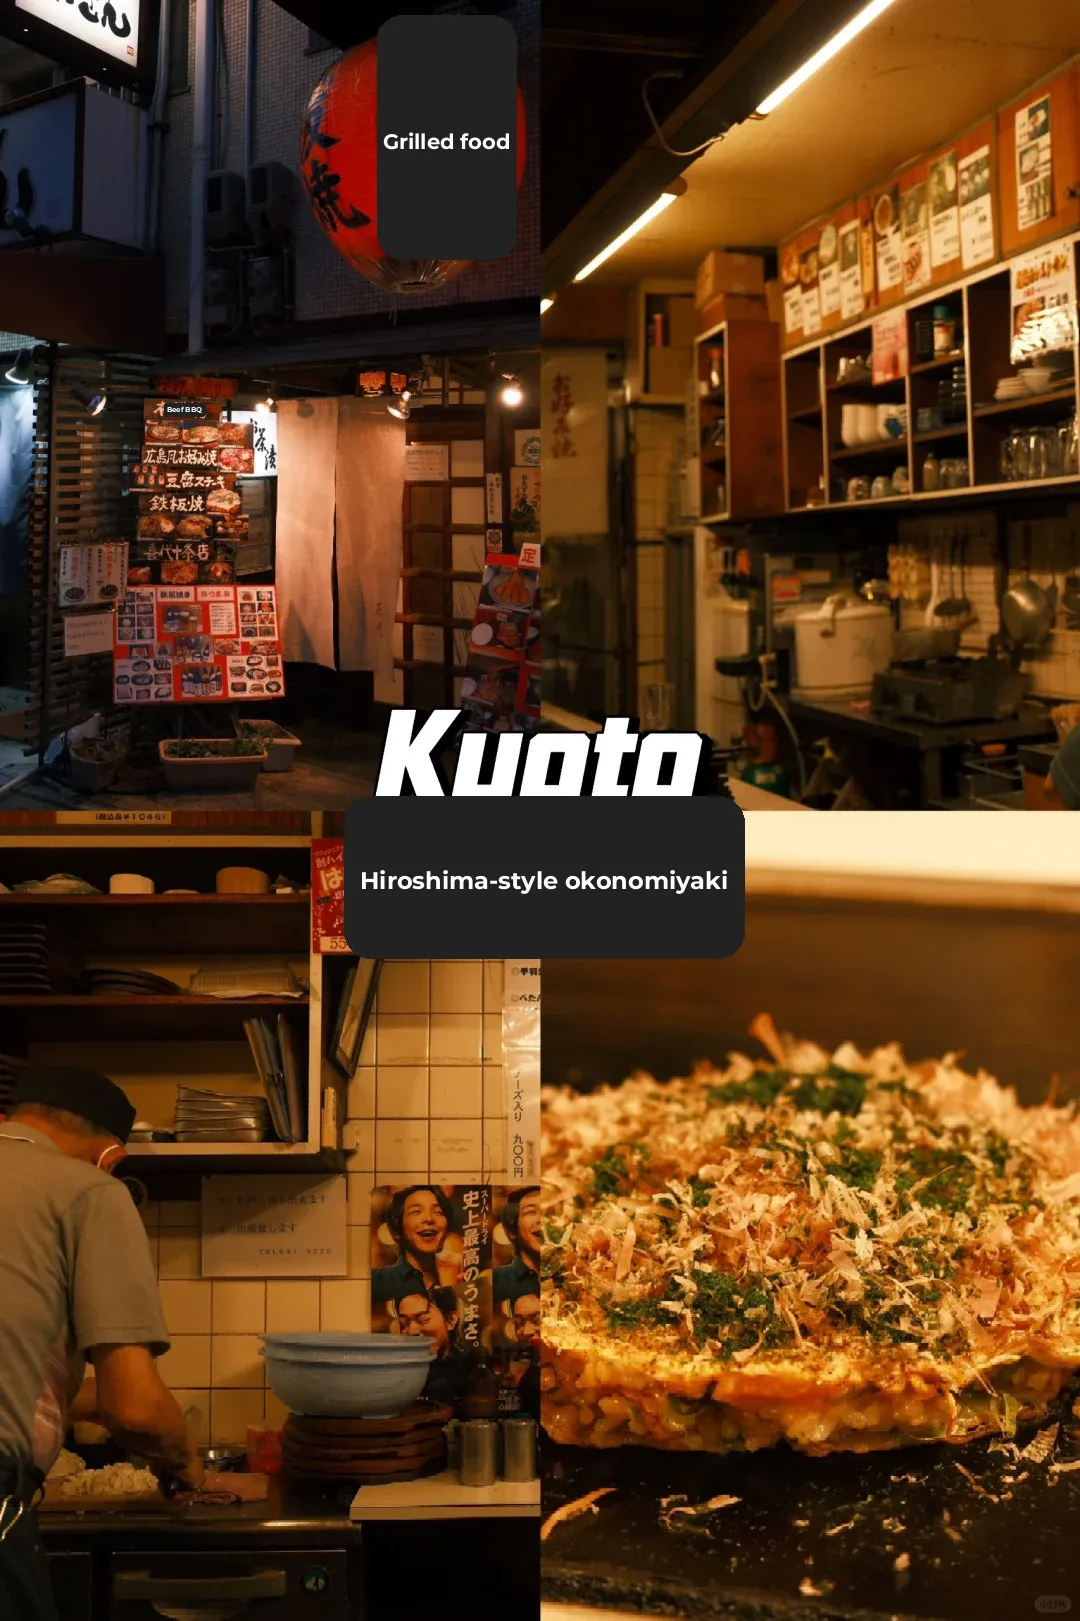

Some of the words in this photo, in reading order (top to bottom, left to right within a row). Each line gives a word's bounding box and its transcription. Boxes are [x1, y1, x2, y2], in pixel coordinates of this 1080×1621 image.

[166, 471, 226, 489] 豆腐ステーキ
[481, 1190, 490, 1245] スーパードライ
[462, 1190, 480, 1347] 史上最高のうまさ。
